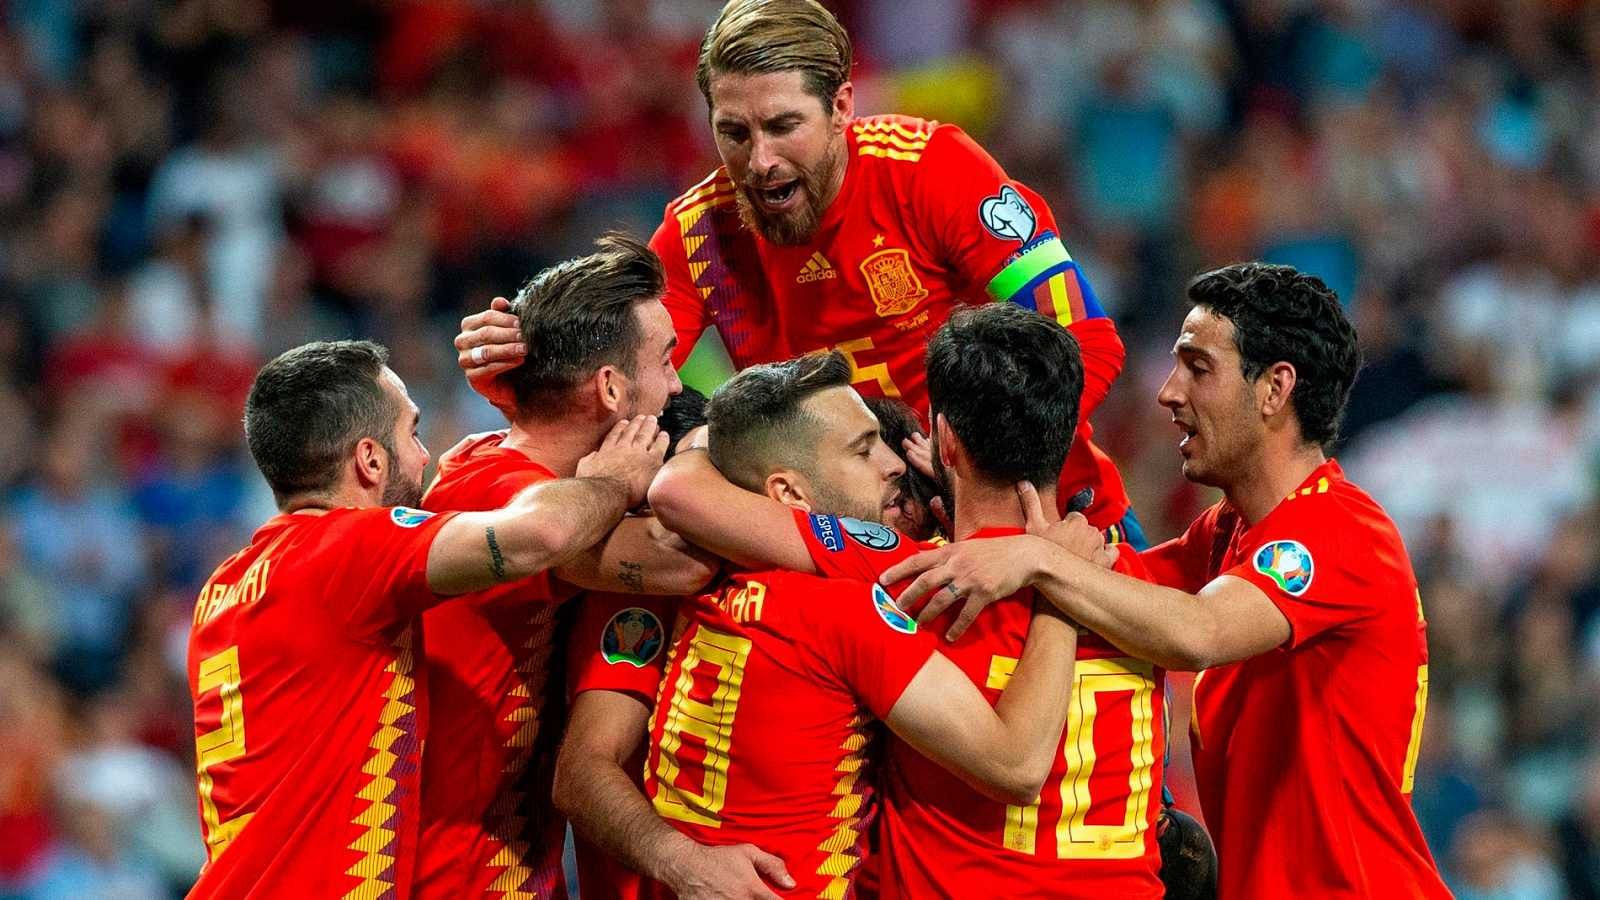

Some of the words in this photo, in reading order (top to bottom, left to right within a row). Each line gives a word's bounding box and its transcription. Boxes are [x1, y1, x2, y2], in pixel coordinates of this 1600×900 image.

[796, 268, 837, 284] adidas
[800, 337, 902, 399] 5
[816, 513, 838, 552] ESPECT
[643, 625, 752, 829] 8
